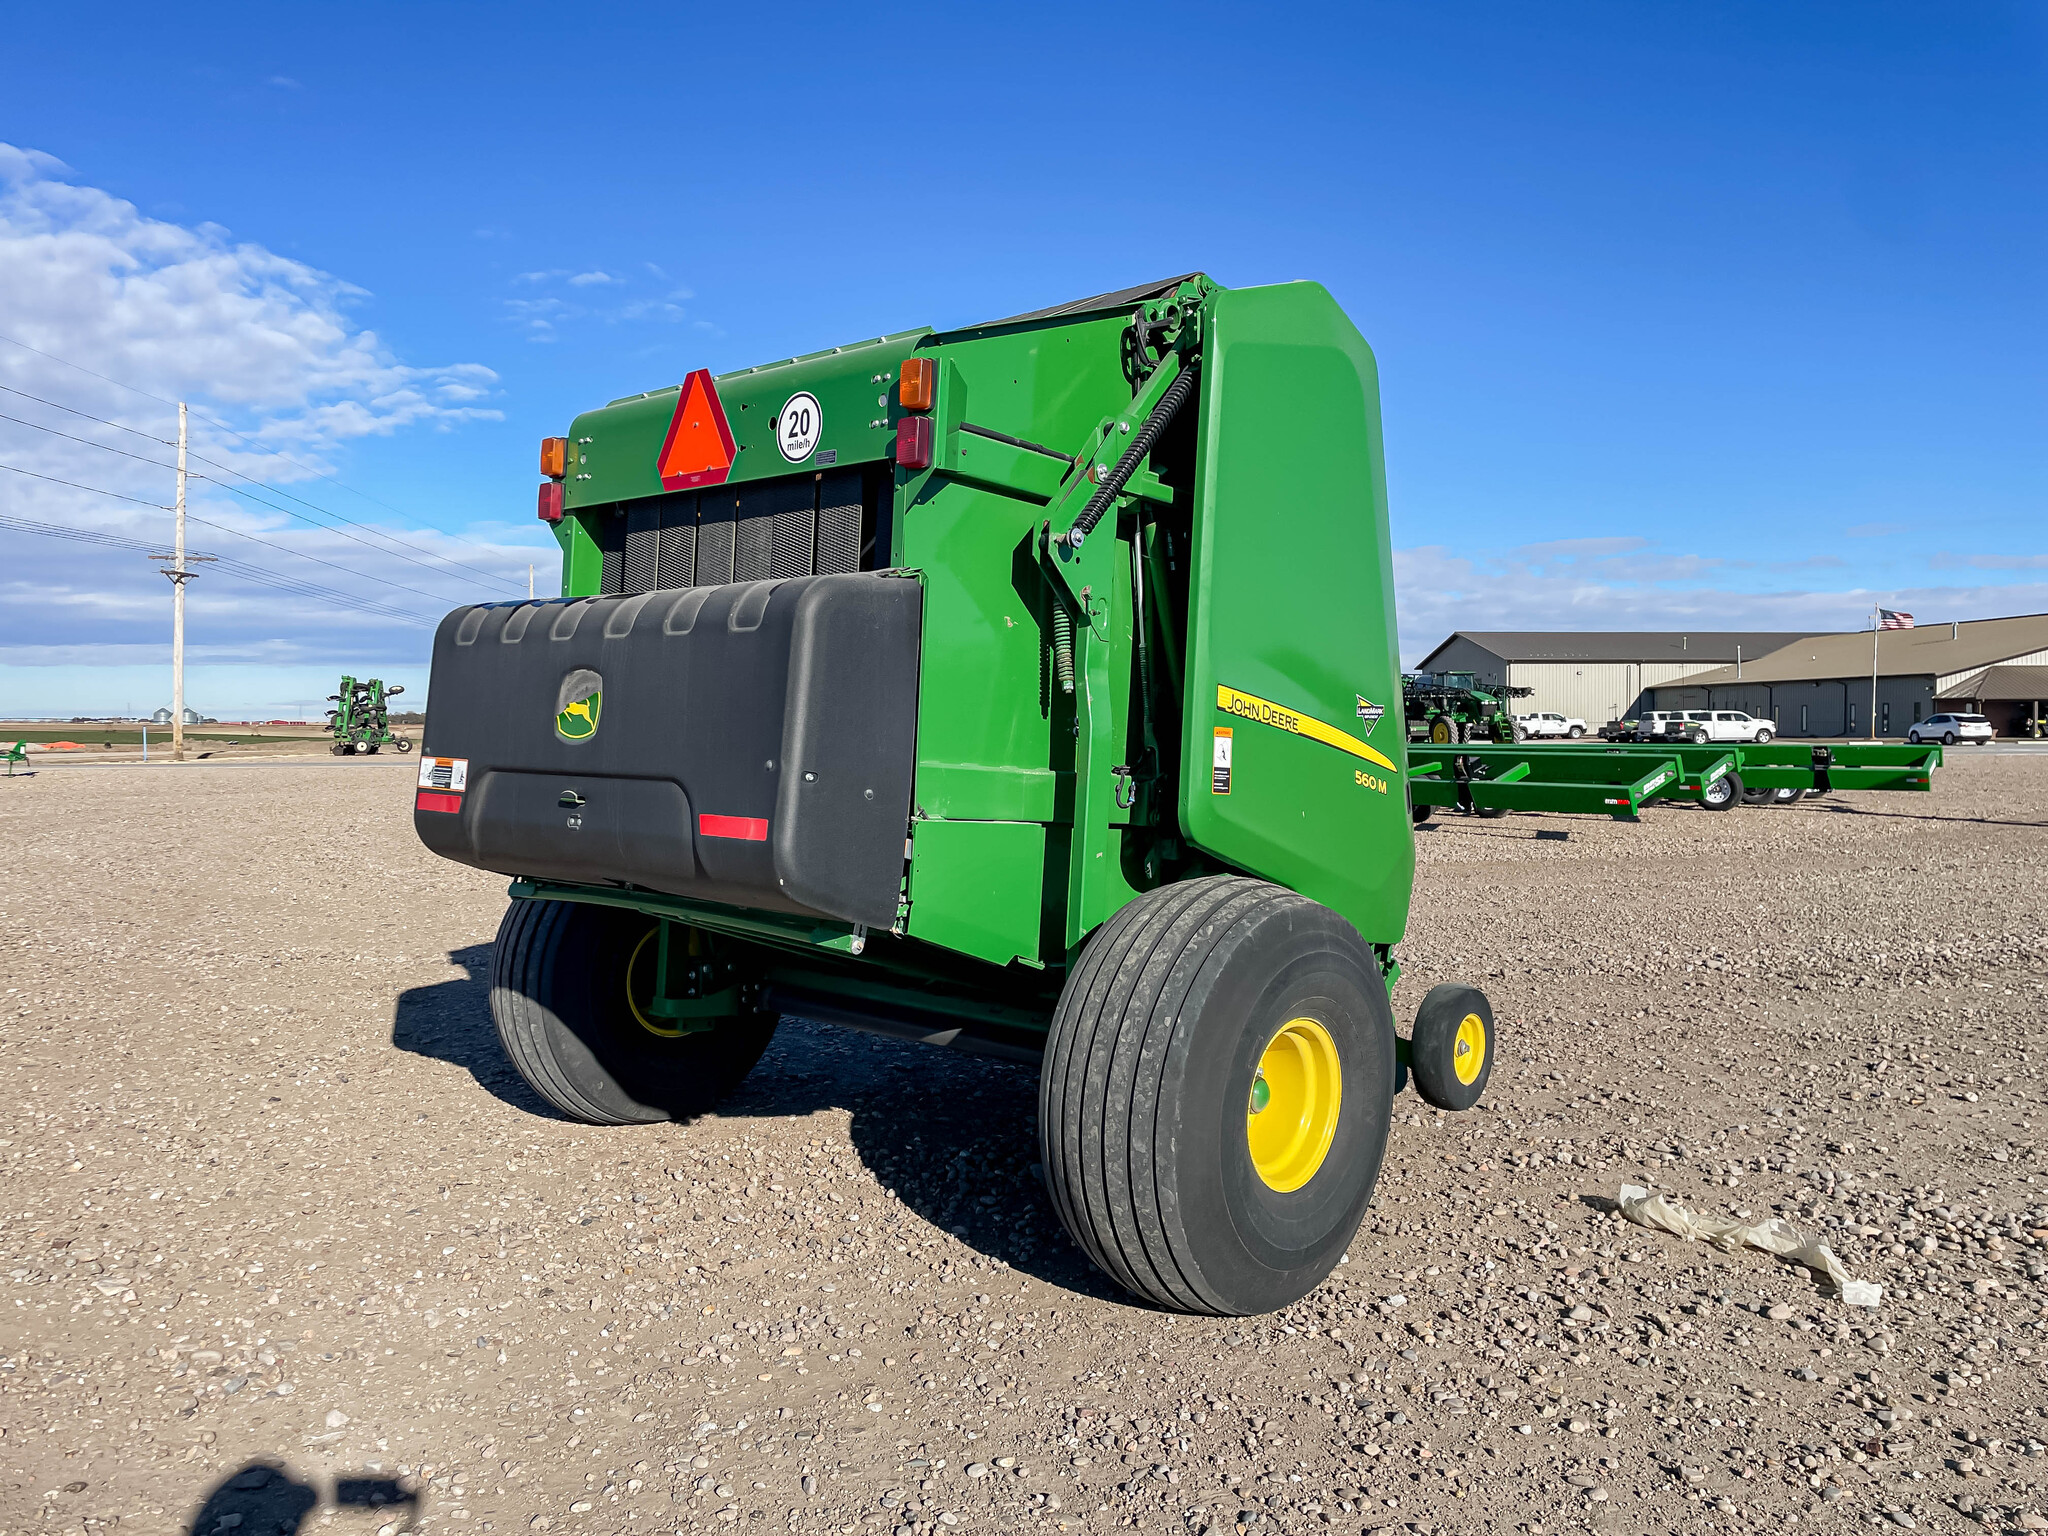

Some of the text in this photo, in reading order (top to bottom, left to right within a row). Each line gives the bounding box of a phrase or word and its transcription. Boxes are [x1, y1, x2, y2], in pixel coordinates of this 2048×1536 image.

[788, 408, 810, 438] 20
[787, 438, 810, 452] mile/h
[1227, 693, 1299, 731] JOHN DEERE
[1355, 769, 1387, 795] 560 M
